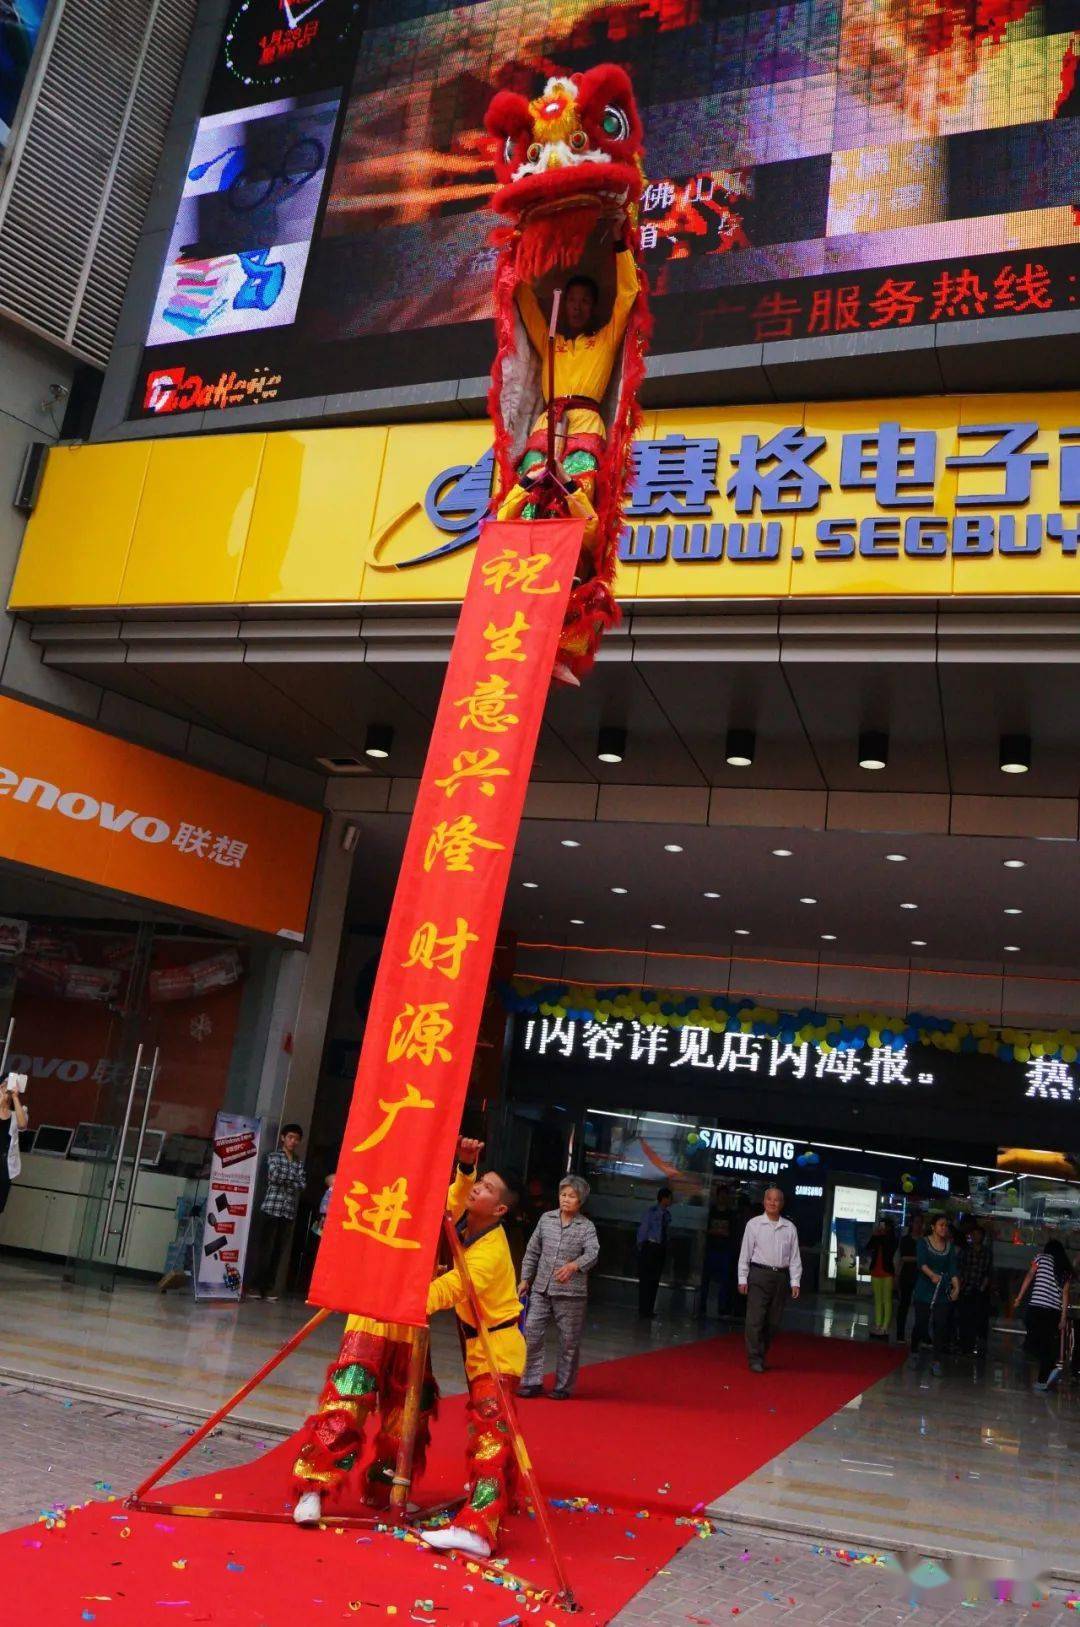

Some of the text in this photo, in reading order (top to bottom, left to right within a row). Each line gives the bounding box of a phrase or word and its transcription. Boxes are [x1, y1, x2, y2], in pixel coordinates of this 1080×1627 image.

[171, 821, 249, 869] 联想
[341, 548, 562, 1250] 祝生意兴隆财源广进
[523, 1017, 1075, 1100] 内容详见店内海报。 热
[698, 1129, 795, 1161] SAMSUNG
